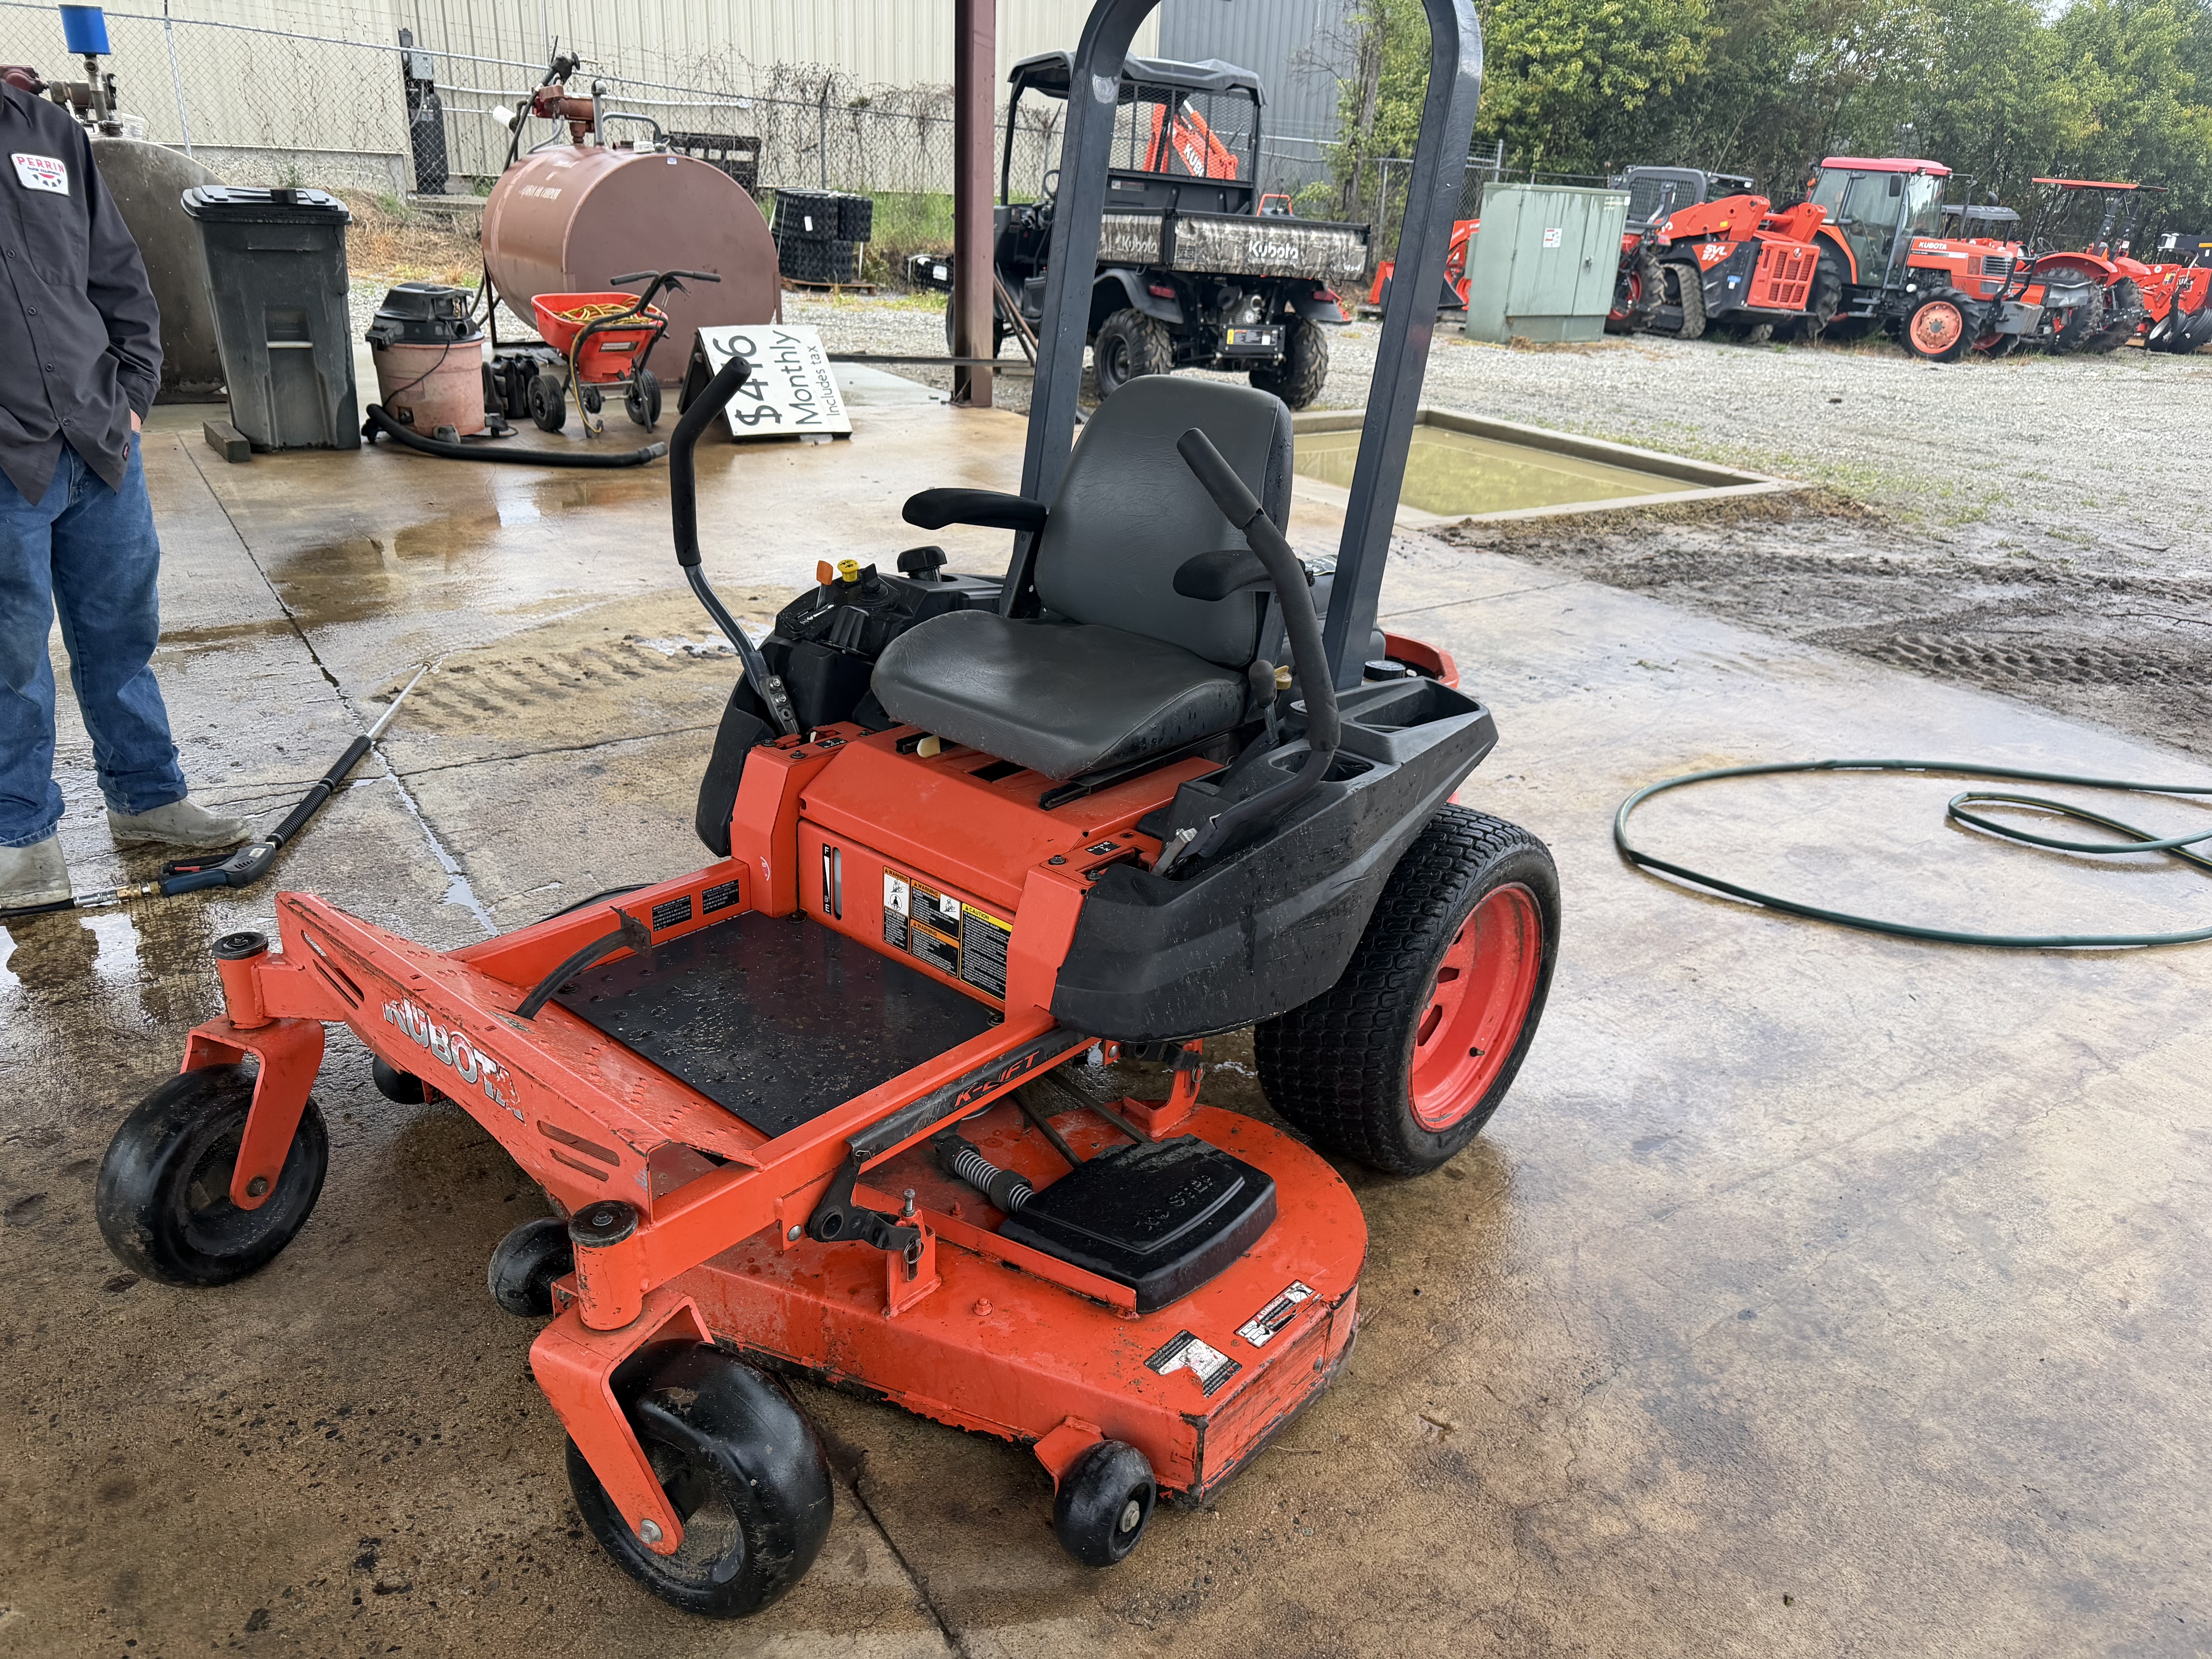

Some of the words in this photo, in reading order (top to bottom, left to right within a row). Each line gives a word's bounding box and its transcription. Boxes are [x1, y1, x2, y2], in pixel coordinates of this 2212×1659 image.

[16, 156, 65, 173] PERRIN
[1123, 235, 1158, 253] Kubota
[1249, 240, 1298, 259] Kubota
[1703, 244, 1727, 256] SVL
[1918, 241, 1947, 250] KUBOTA
[807, 345, 821, 365] tax
[769, 330, 822, 424] Monthly
[816, 368, 840, 416] Includes
[889, 869, 908, 883] WARNING
[917, 883, 938, 896] WARNING
[969, 907, 989, 921] CAUTION
[917, 922, 937, 937] WARNING
[954, 1050, 1040, 1108] K-LIFT
[1261, 1296, 1285, 1317] DANGER
[1173, 1329, 1188, 1341] SETTING
